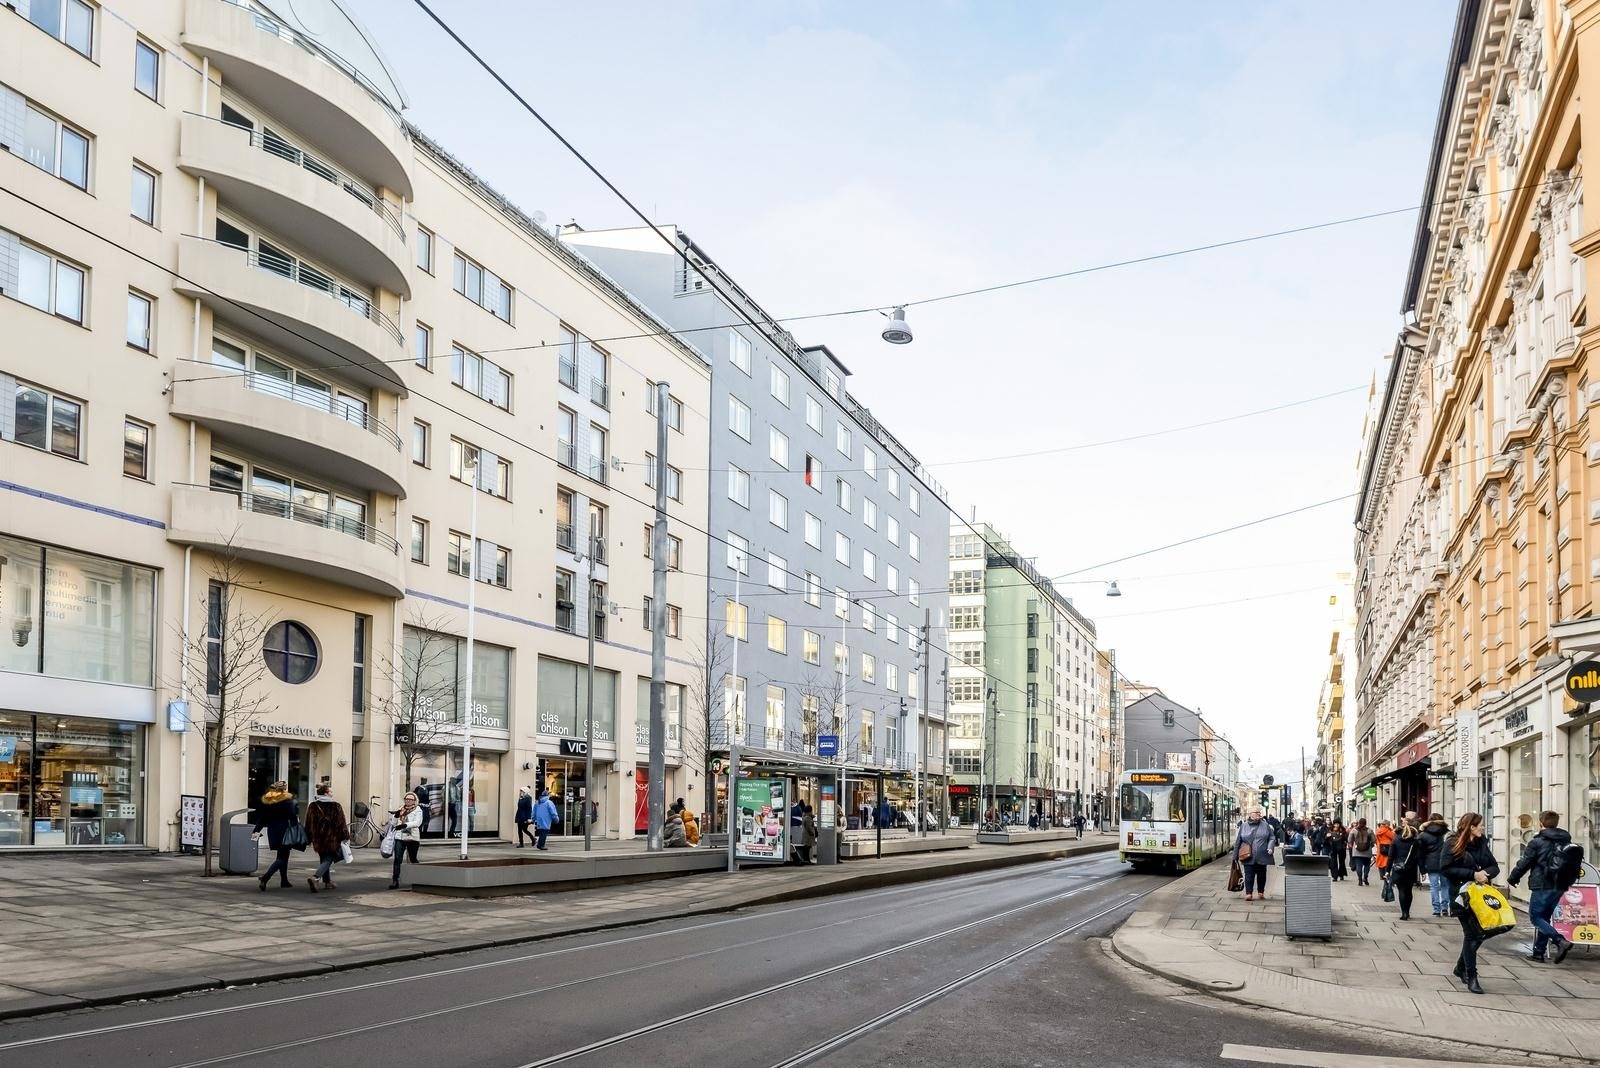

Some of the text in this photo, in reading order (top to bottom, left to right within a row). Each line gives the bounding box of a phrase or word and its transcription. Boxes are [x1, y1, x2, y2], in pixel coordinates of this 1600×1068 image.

[541, 711, 559, 723] clas
[318, 728, 332, 738] 26
[540, 722, 569, 735] ohlson
[635, 734, 650, 745] ohls
[1146, 839, 1157, 847] 133
[1580, 932, 1594, 941] 99
